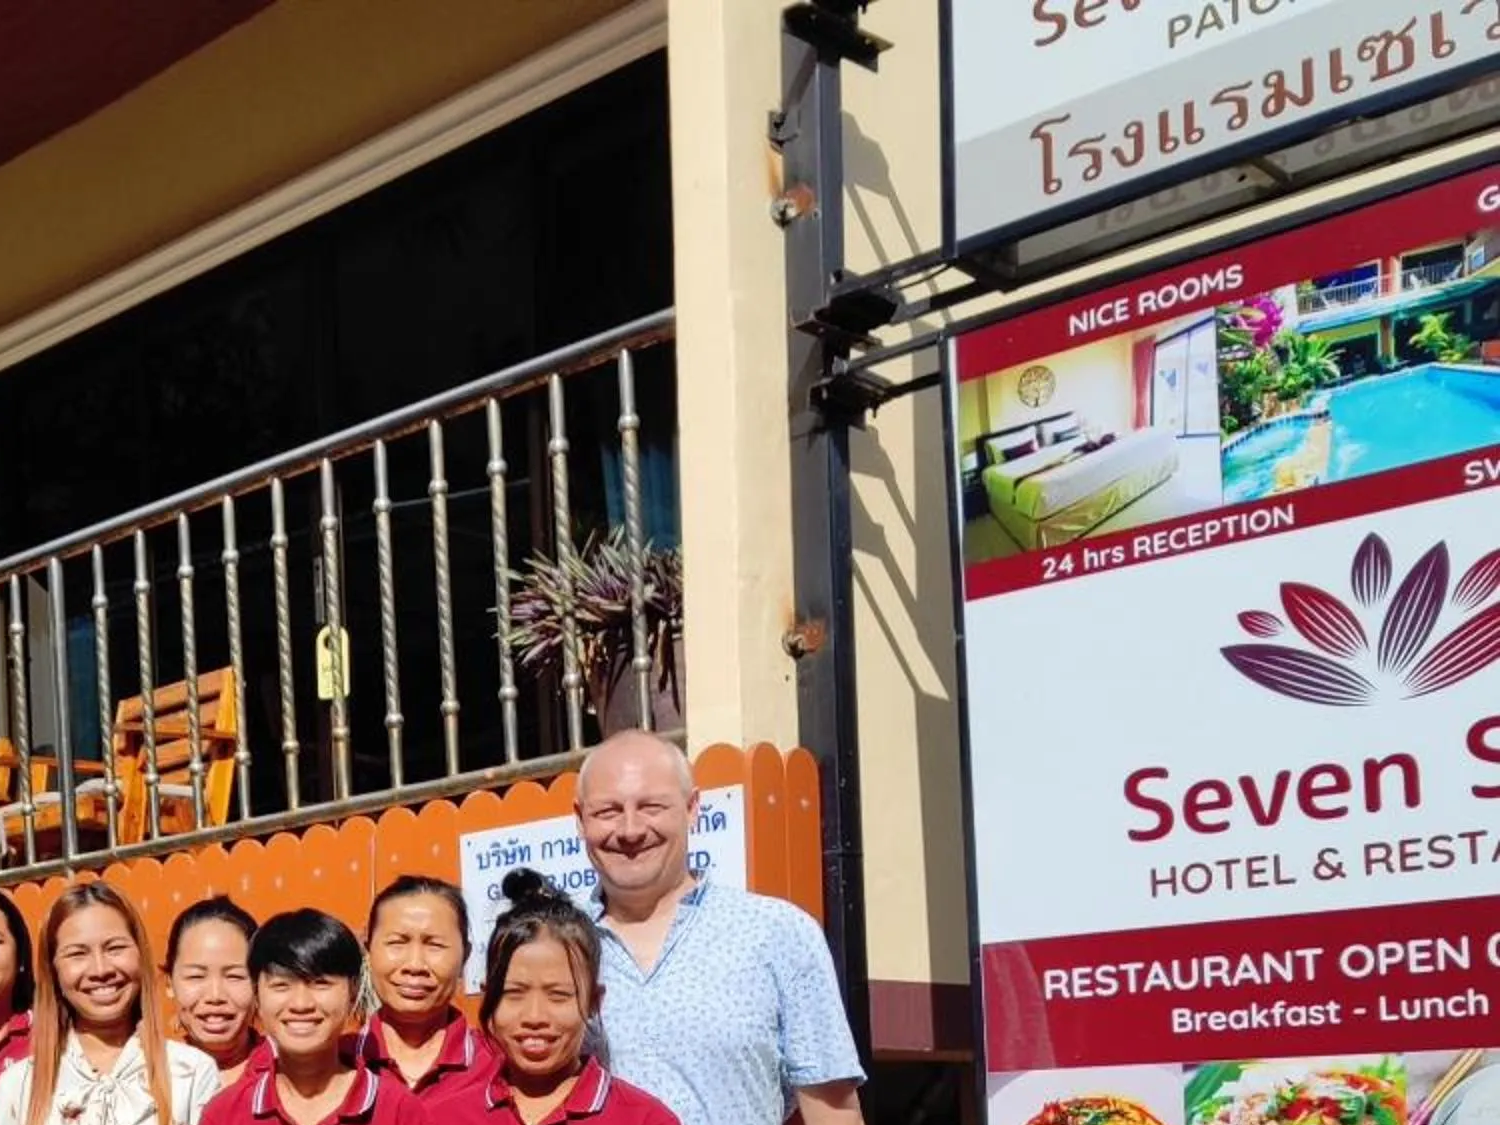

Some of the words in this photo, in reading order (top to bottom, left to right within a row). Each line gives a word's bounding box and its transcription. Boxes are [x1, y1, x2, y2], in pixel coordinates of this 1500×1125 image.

[1033, 0, 1140, 47] Se
[1068, 304, 1130, 338] NICE
[1138, 264, 1245, 317] ROOMS
[1041, 554, 1075, 580] 24
[1083, 540, 1126, 572] hrs
[1133, 503, 1296, 558] RECEPTION
[1123, 750, 1422, 842] Seven
[1150, 855, 1297, 899] HOTEL
[1313, 847, 1348, 881] &
[1363, 829, 1500, 877] REST
[1044, 947, 1324, 1001] RESTAURANT
[1339, 935, 1471, 979] OPEN
[1172, 994, 1341, 1034] Breakfast
[1379, 987, 1490, 1021] Lunch
